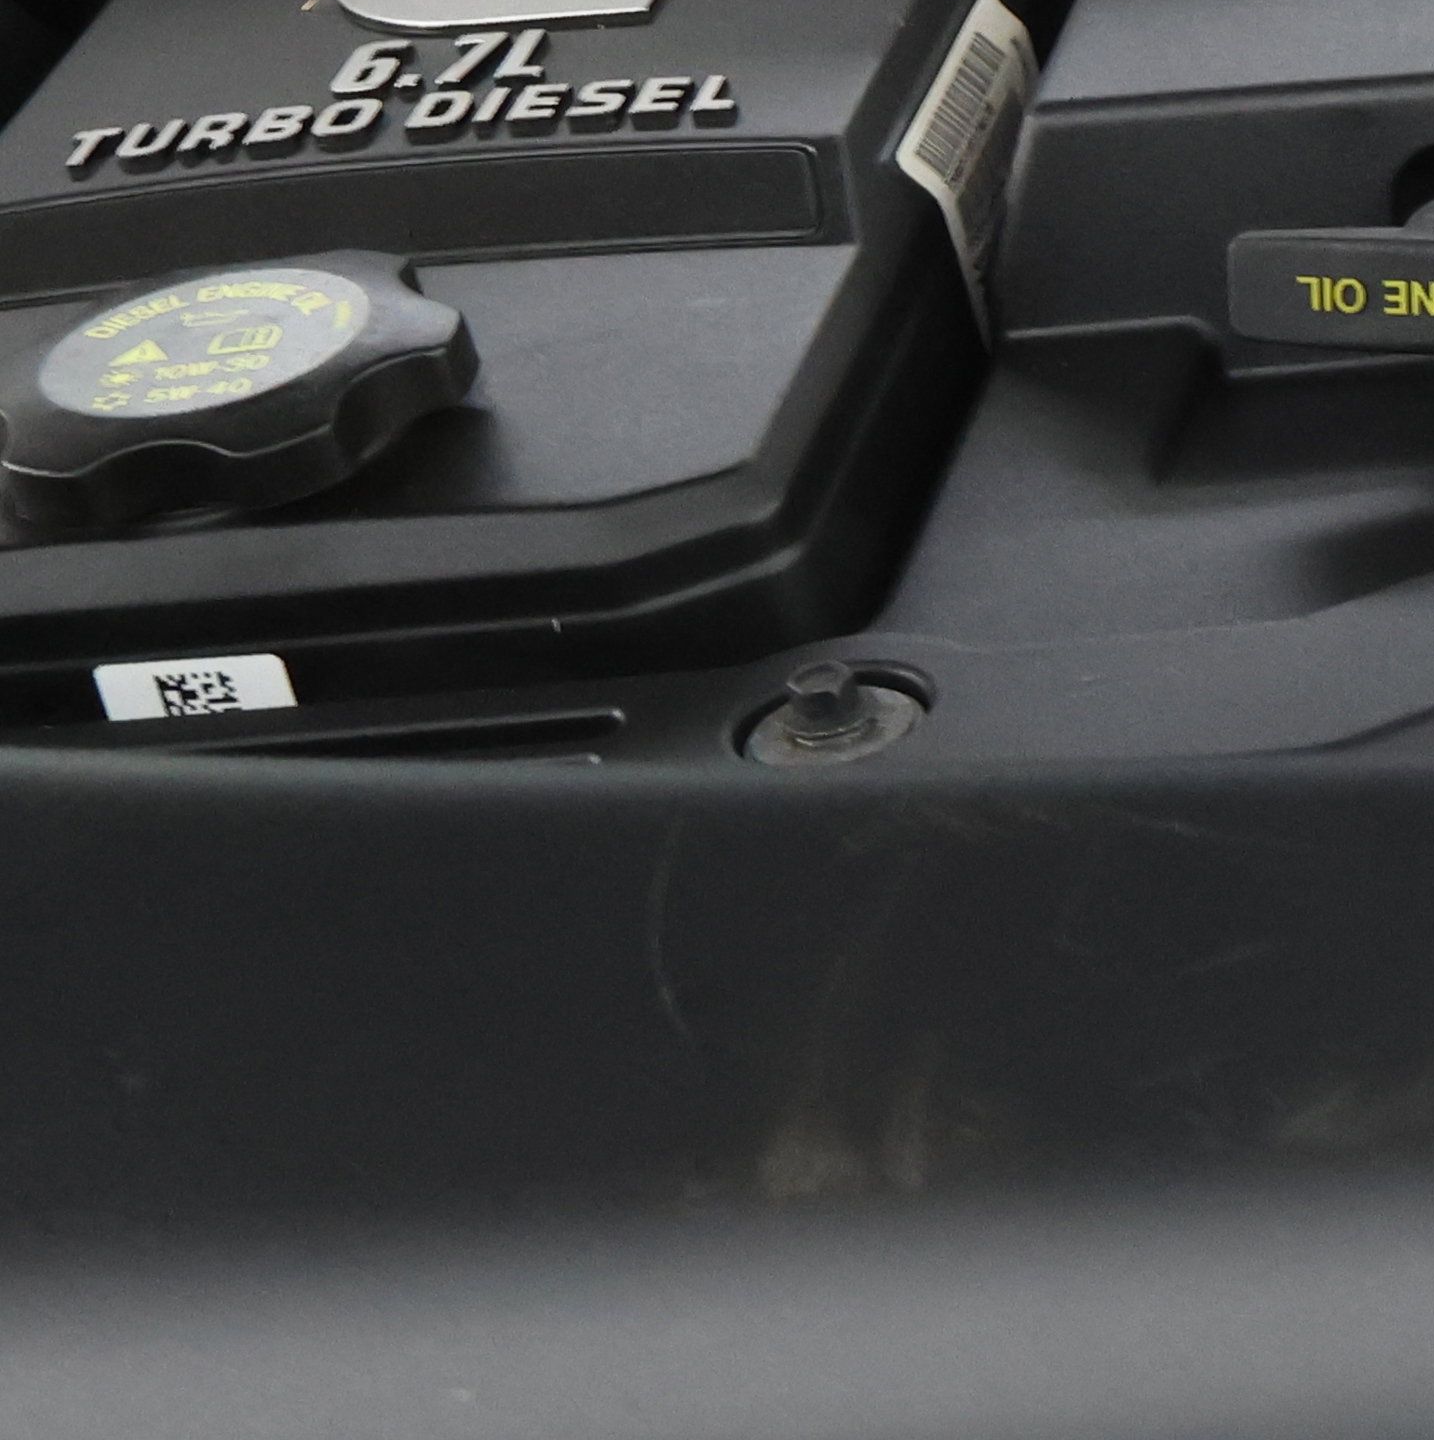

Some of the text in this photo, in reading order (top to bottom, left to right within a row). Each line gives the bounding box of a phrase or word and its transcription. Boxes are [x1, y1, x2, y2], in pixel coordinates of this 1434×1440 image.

[329, 28, 548, 96] 6.7L
[65, 74, 737, 169] TURBO DIESEL
[84, 293, 191, 341] DIESEL
[1295, 275, 1369, 315] OIL
